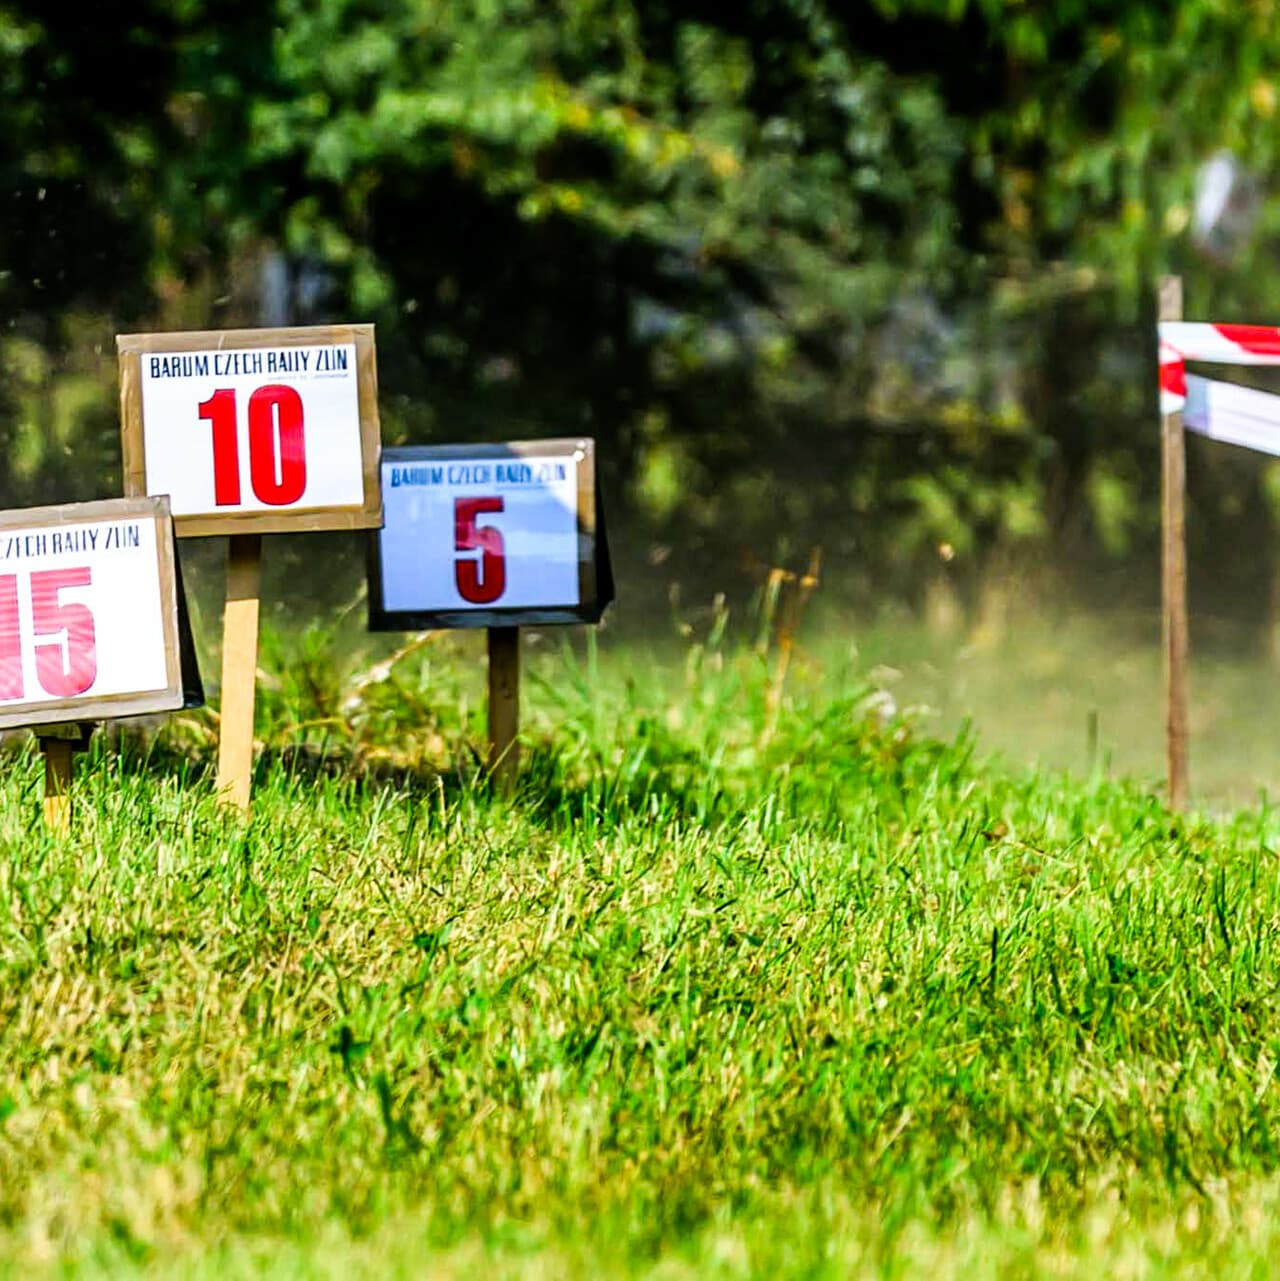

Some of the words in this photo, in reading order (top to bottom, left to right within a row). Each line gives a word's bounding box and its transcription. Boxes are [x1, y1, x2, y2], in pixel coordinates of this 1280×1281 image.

[150, 354, 209, 379] BARUM
[215, 352, 262, 376] CZECH
[267, 350, 310, 374] RALLY
[197, 382, 306, 506] 10
[454, 495, 506, 605] 5
